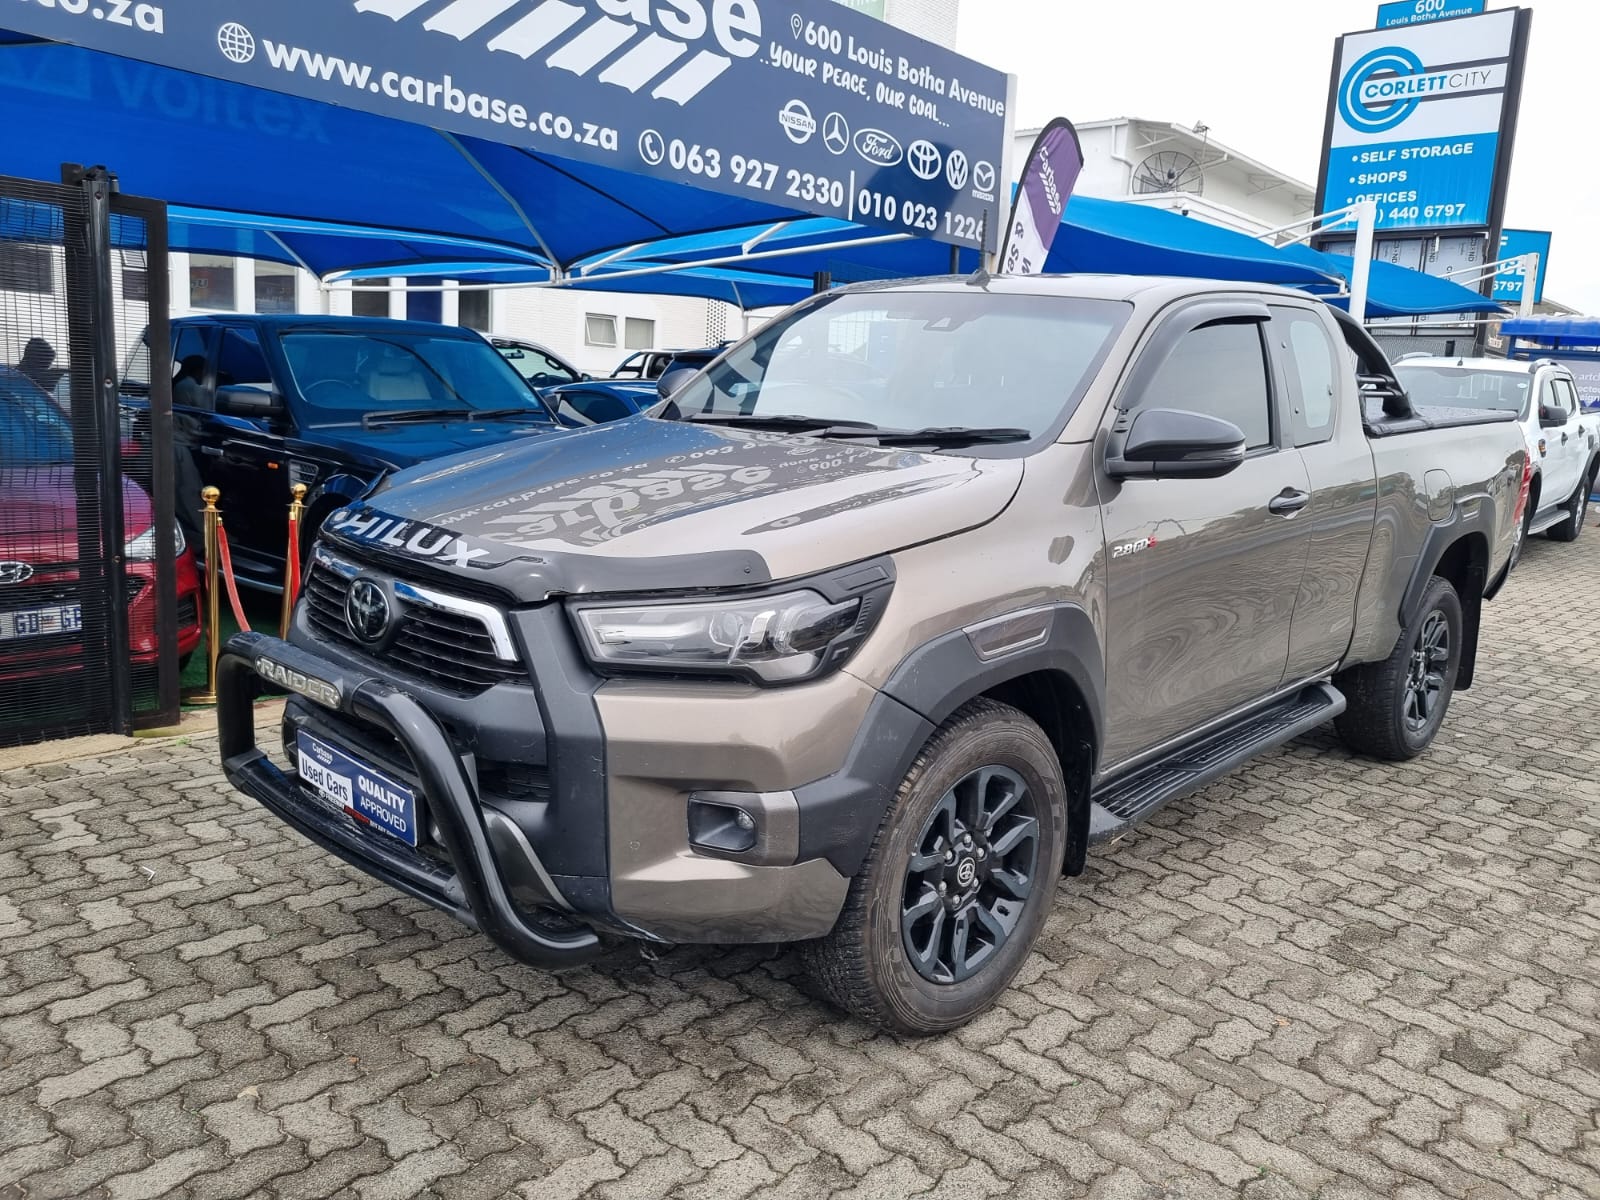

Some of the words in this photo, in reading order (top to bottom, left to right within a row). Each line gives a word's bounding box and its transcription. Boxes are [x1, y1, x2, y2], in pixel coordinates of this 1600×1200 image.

[1386, 15, 1408, 26] Louis
[1411, 11, 1437, 22] Botha
[1439, 7, 1473, 18] Avenue
[1415, 0, 1445, 13] 600
[804, 21, 842, 55] 600
[848, 36, 893, 75] Louis
[898, 56, 945, 95] Botha
[949, 78, 1004, 117] Avenue
[262, 39, 618, 152] www.carbase.co.za
[780, 114, 815, 132] NISSAN
[862, 133, 895, 160] Ford
[1360, 150, 1396, 163] SELF
[1401, 142, 1474, 160] STORAGE
[669, 138, 721, 178] 063
[731, 155, 779, 191] 927
[786, 169, 844, 208] 2330
[858, 189, 896, 221] 010
[903, 200, 937, 231] 023
[1358, 171, 1407, 185] SHOPS
[1355, 190, 1417, 205] OFFICES
[1389, 207, 1419, 219] 440
[1424, 203, 1465, 217] 6797
[333, 513, 490, 568] HILUX
[260, 657, 336, 705] RAIDER
[301, 757, 323, 786] Used
[326, 771, 348, 802] Cars
[358, 774, 405, 813] QUALITY
[360, 796, 406, 833] APPROVED
